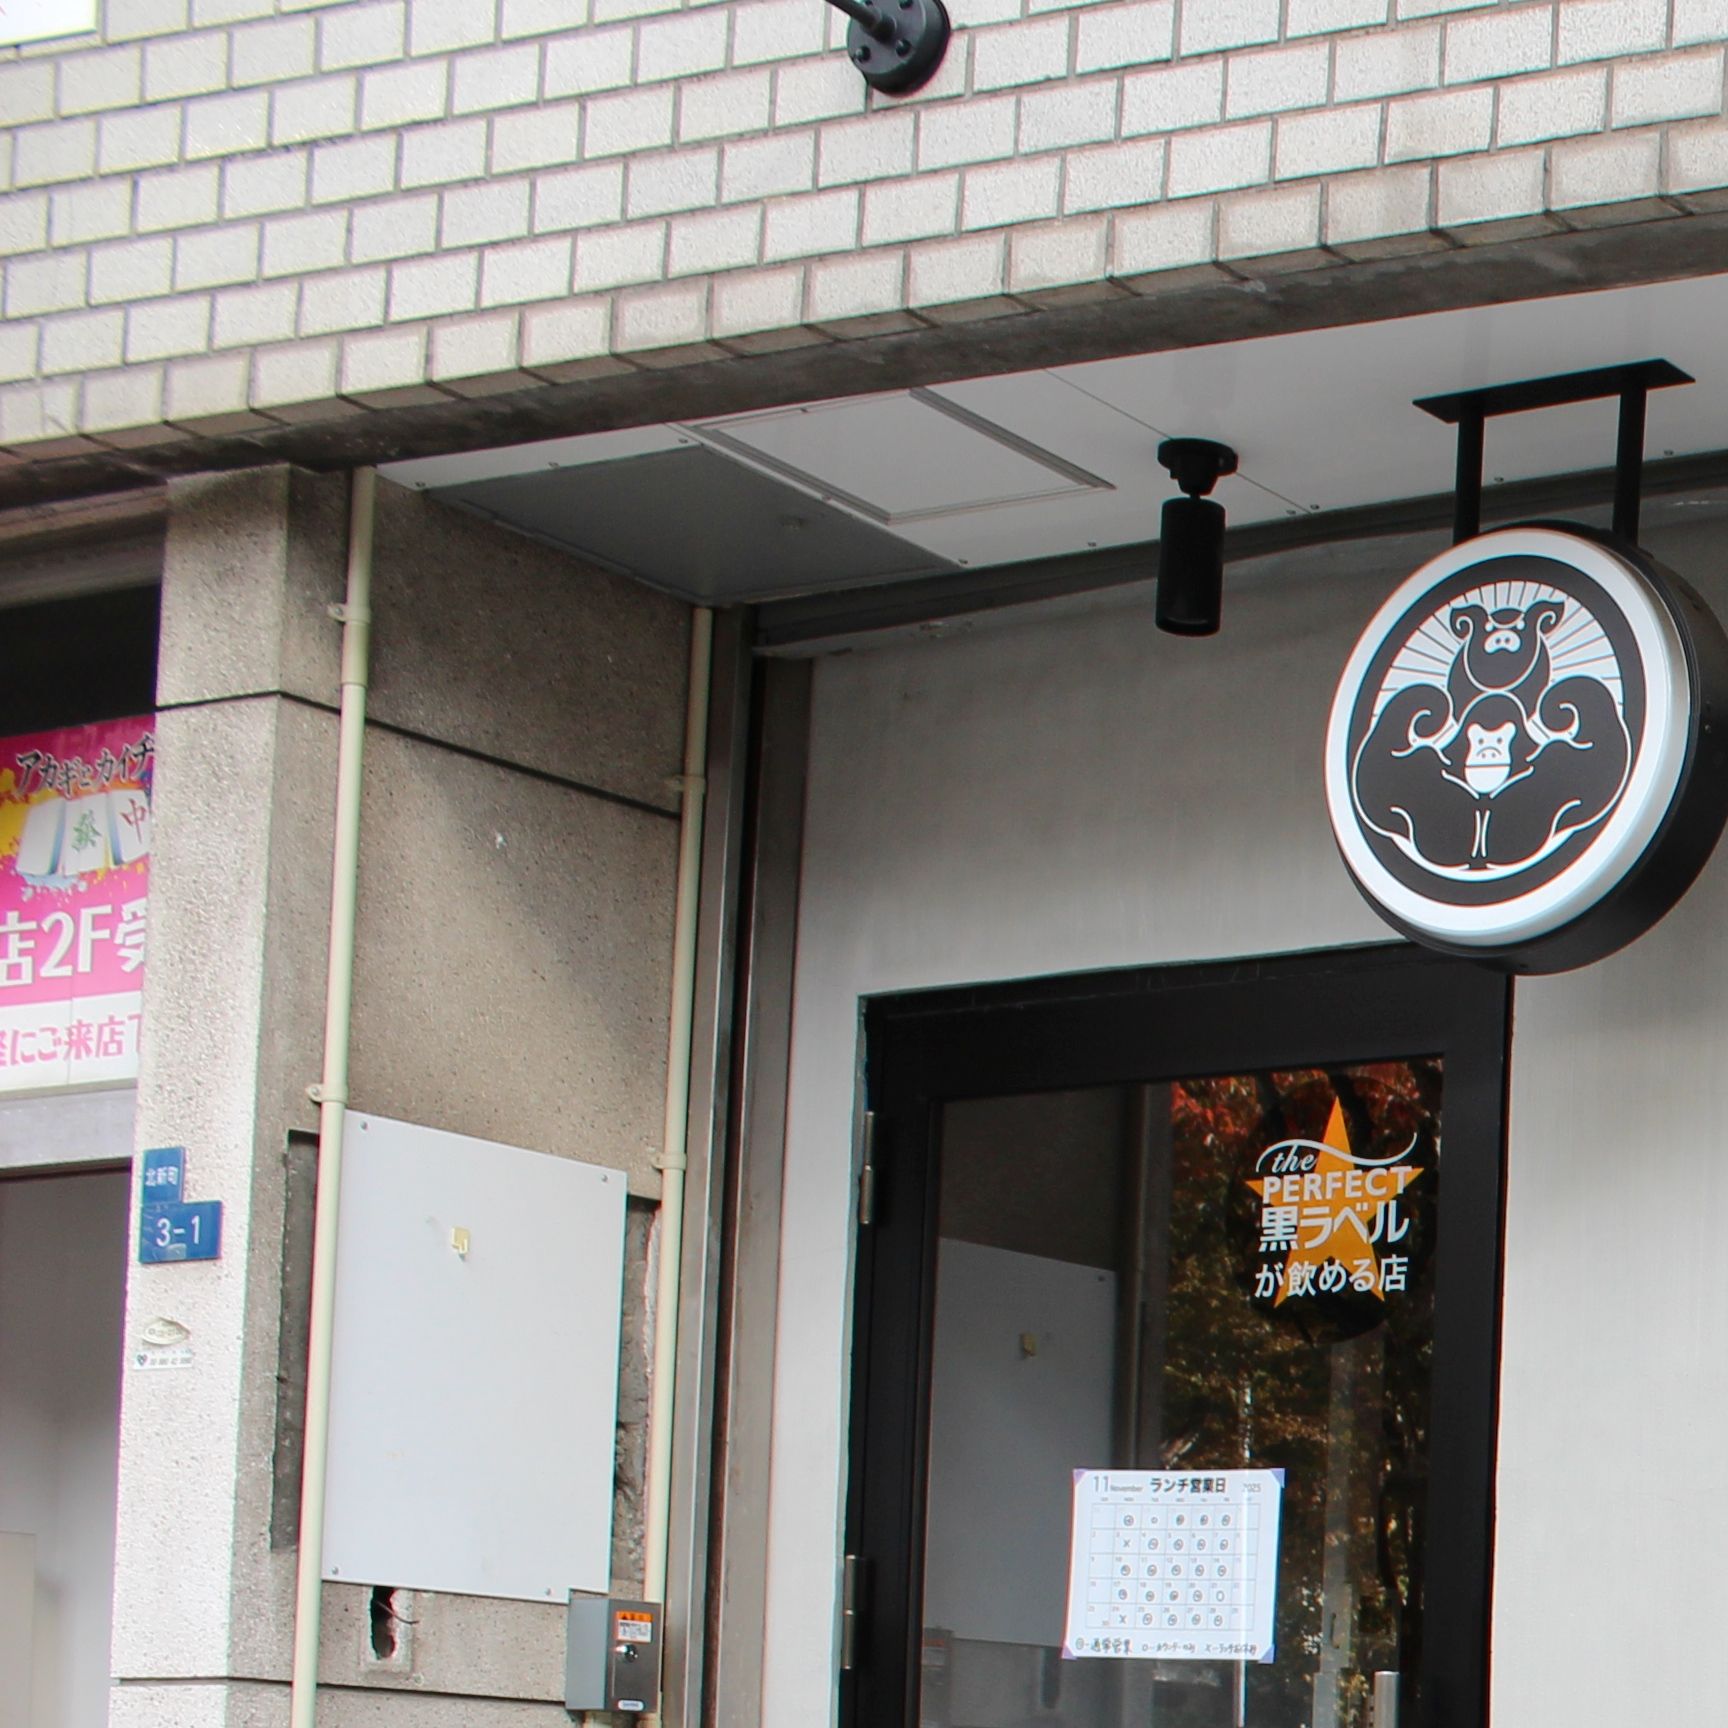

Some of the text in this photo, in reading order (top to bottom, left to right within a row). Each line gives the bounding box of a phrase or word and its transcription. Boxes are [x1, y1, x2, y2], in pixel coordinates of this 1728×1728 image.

[1272, 1145, 1317, 1173] the
[145, 1166, 178, 1187] 北新町
[1263, 1165, 1413, 1204] PERFECT
[156, 1214, 201, 1247] 3-1
[1259, 1200, 1410, 1252] 黒ラベル
[1254, 1254, 1408, 1298] が飲める店
[1093, 1475, 1110, 1492] 11
[1150, 1477, 1226, 1494] ランチ営業日
